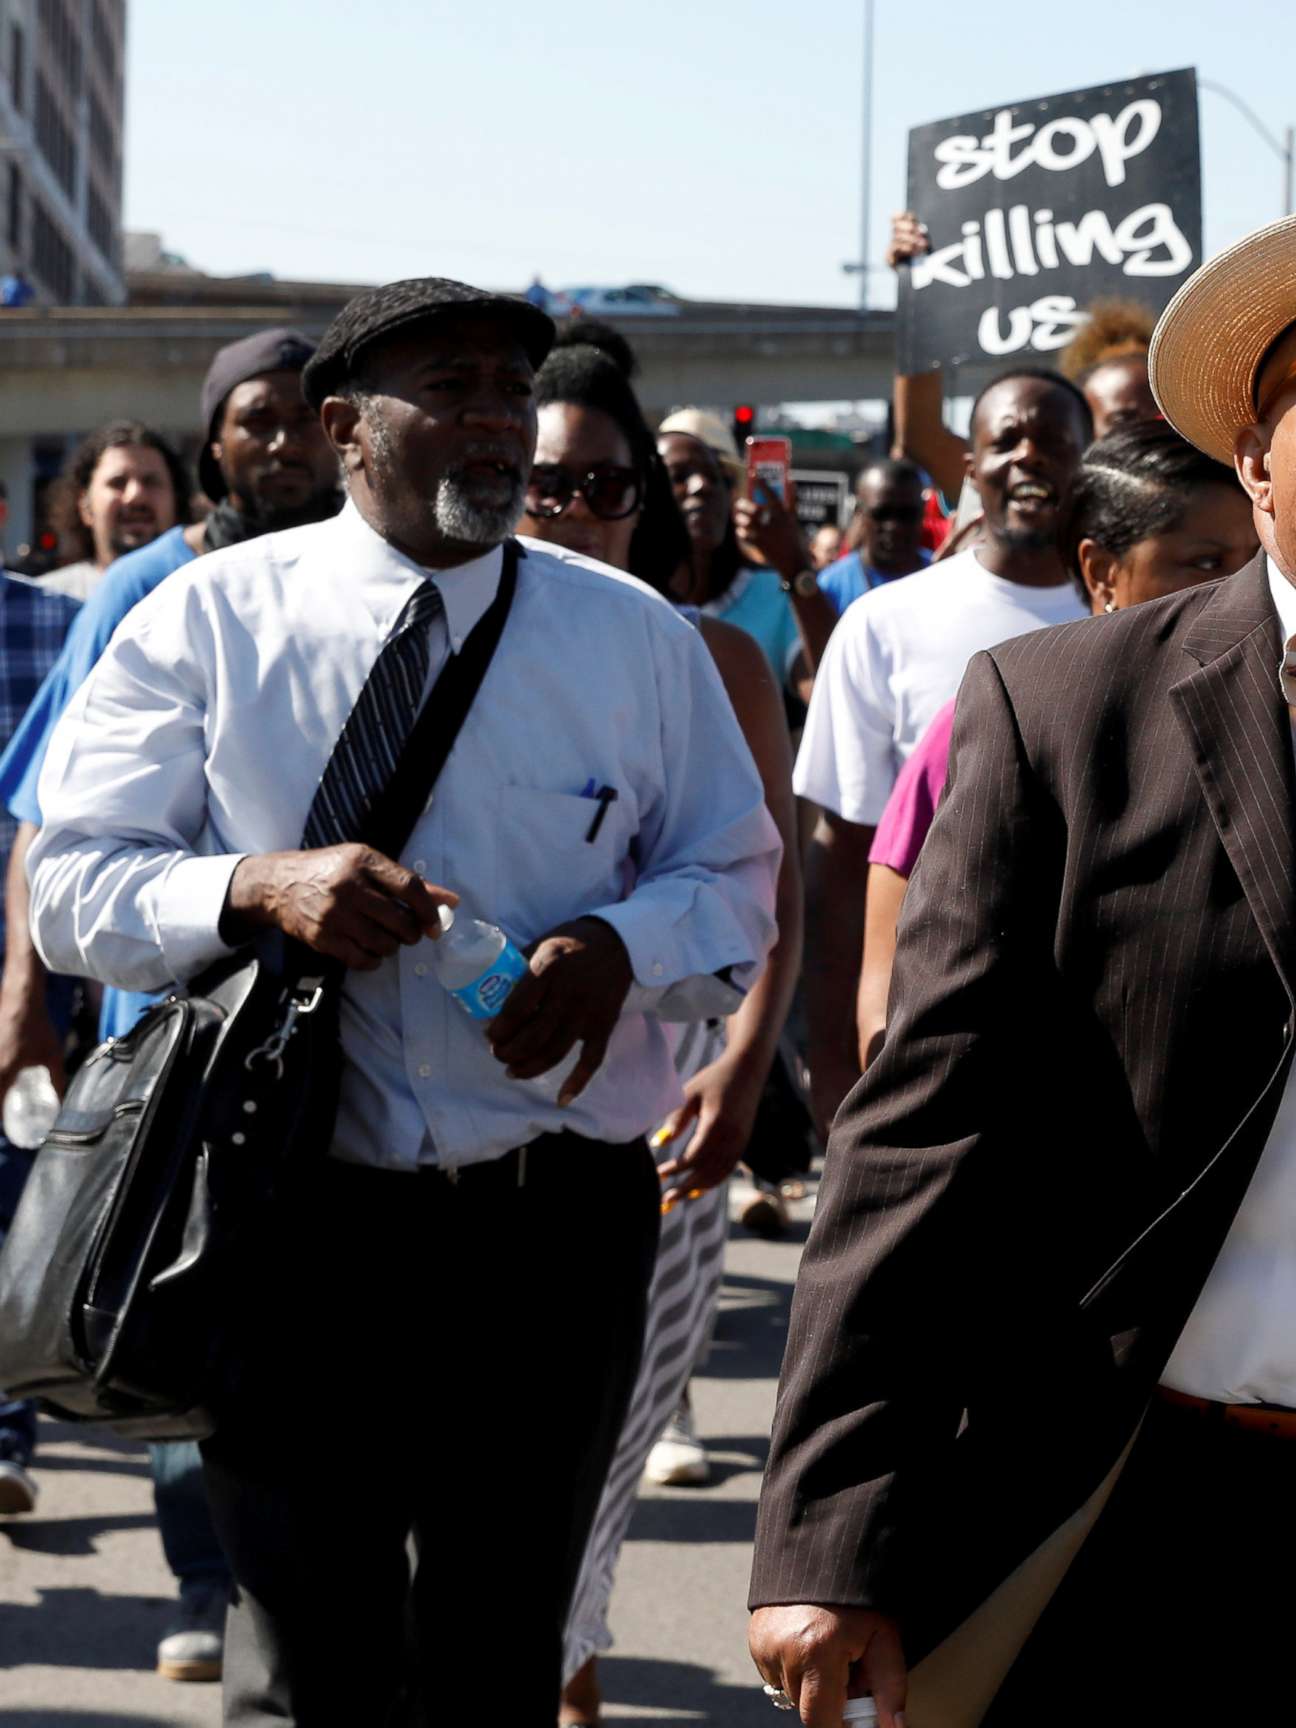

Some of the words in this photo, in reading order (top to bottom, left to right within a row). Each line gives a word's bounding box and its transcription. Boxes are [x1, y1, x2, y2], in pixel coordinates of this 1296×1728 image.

[934, 98, 1162, 190] stop
[911, 202, 1192, 290] killing
[977, 295, 1093, 355] us
